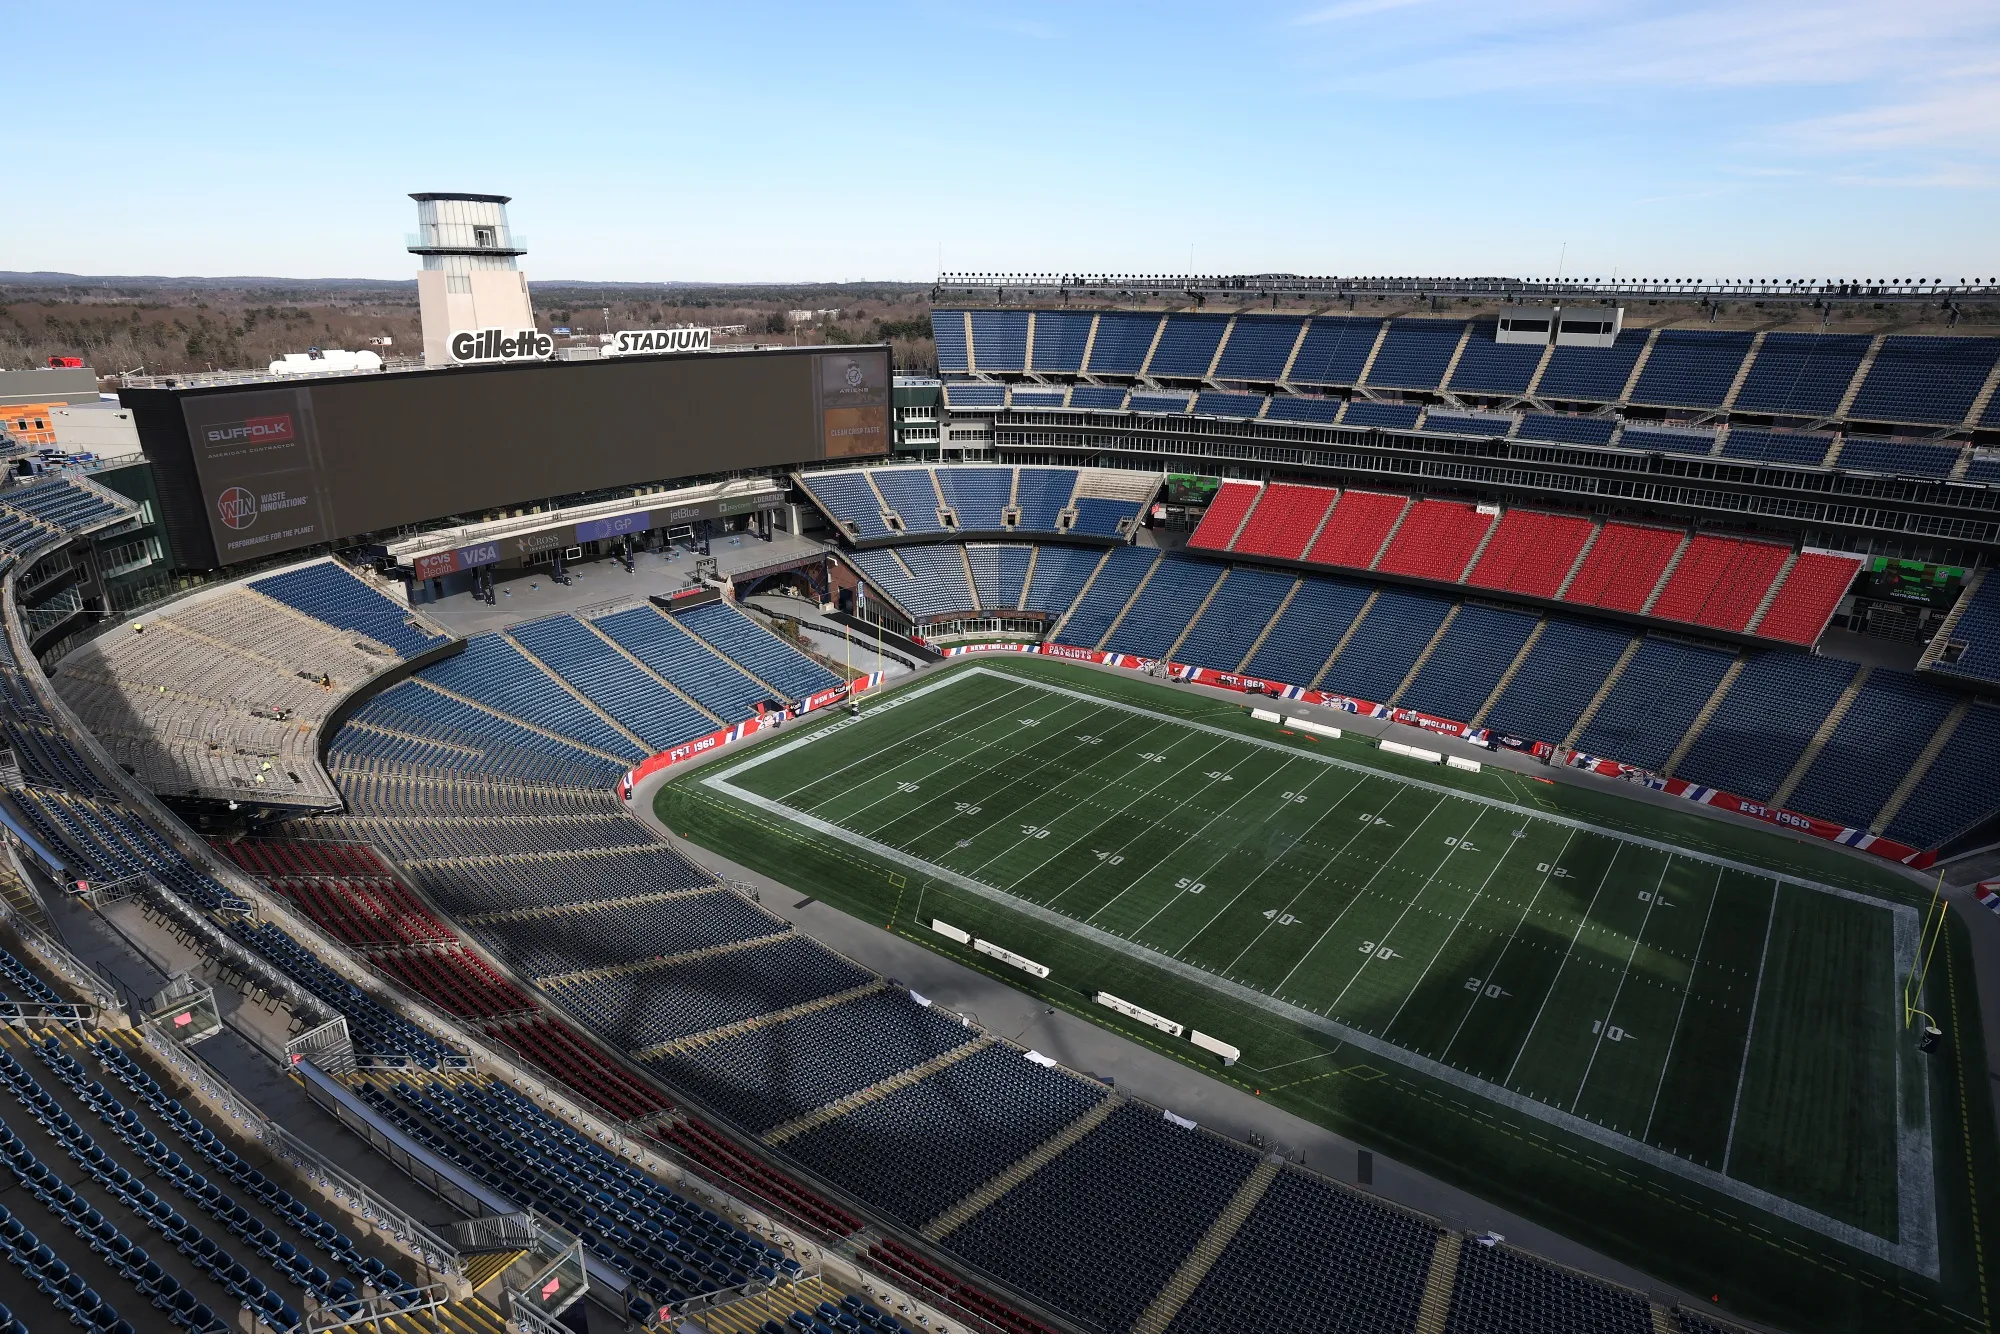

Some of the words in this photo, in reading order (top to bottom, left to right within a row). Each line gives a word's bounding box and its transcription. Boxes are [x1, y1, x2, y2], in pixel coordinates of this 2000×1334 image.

[452, 330, 552, 360] Gillette
[618, 331, 709, 351] STADIUM
[208, 422, 286, 442] SUFFOLK
[831, 428, 848, 437] CLEAN
[849, 427, 864, 436] CRISP
[864, 426, 880, 434] TASTE
[207, 449, 247, 459] AMERICA'S
[250, 443, 295, 453] CONTRACTOR
[260, 497, 307, 512] INNOVATIONS
[261, 491, 286, 504] WASTE
[670, 507, 699, 522] jetBlue
[227, 535, 270, 550] PERFORMANCE
[270, 532, 282, 541] FOR
[283, 530, 294, 538] THE
[294, 525, 314, 536] PLANET
[430, 553, 450, 566] CVS
[462, 546, 497, 564] VISA
[1048, 646, 1092, 660] PATRIOTS
[1244, 678, 1265, 690] 1960
[814, 694, 828, 705] NEW
[1021, 718, 1041, 727] 10
[1078, 735, 1103, 745] 20
[1420, 718, 1458, 732] NGLAND
[805, 734, 818, 742] IT
[670, 745, 690, 760] EST
[694, 737, 715, 752] 1960
[1740, 801, 1771, 818] EST.
[1775, 811, 1810, 829] 1960
[1142, 752, 1166, 763] 30
[1208, 771, 1234, 782] 40
[1281, 791, 1308, 804] 50
[1358, 813, 1386, 825] 40
[1444, 836, 1474, 851] 30
[1536, 862, 1568, 878] 20
[1638, 890, 1664, 906] 10
[898, 782, 920, 793] 10
[955, 802, 982, 815] 20
[1022, 825, 1050, 839] 30
[1096, 850, 1125, 866] 40
[1174, 878, 1206, 894] 50
[1262, 909, 1295, 926] 40
[1358, 941, 1394, 960] 30
[1464, 977, 1500, 999] 20
[1592, 1020, 1623, 1042] 10
